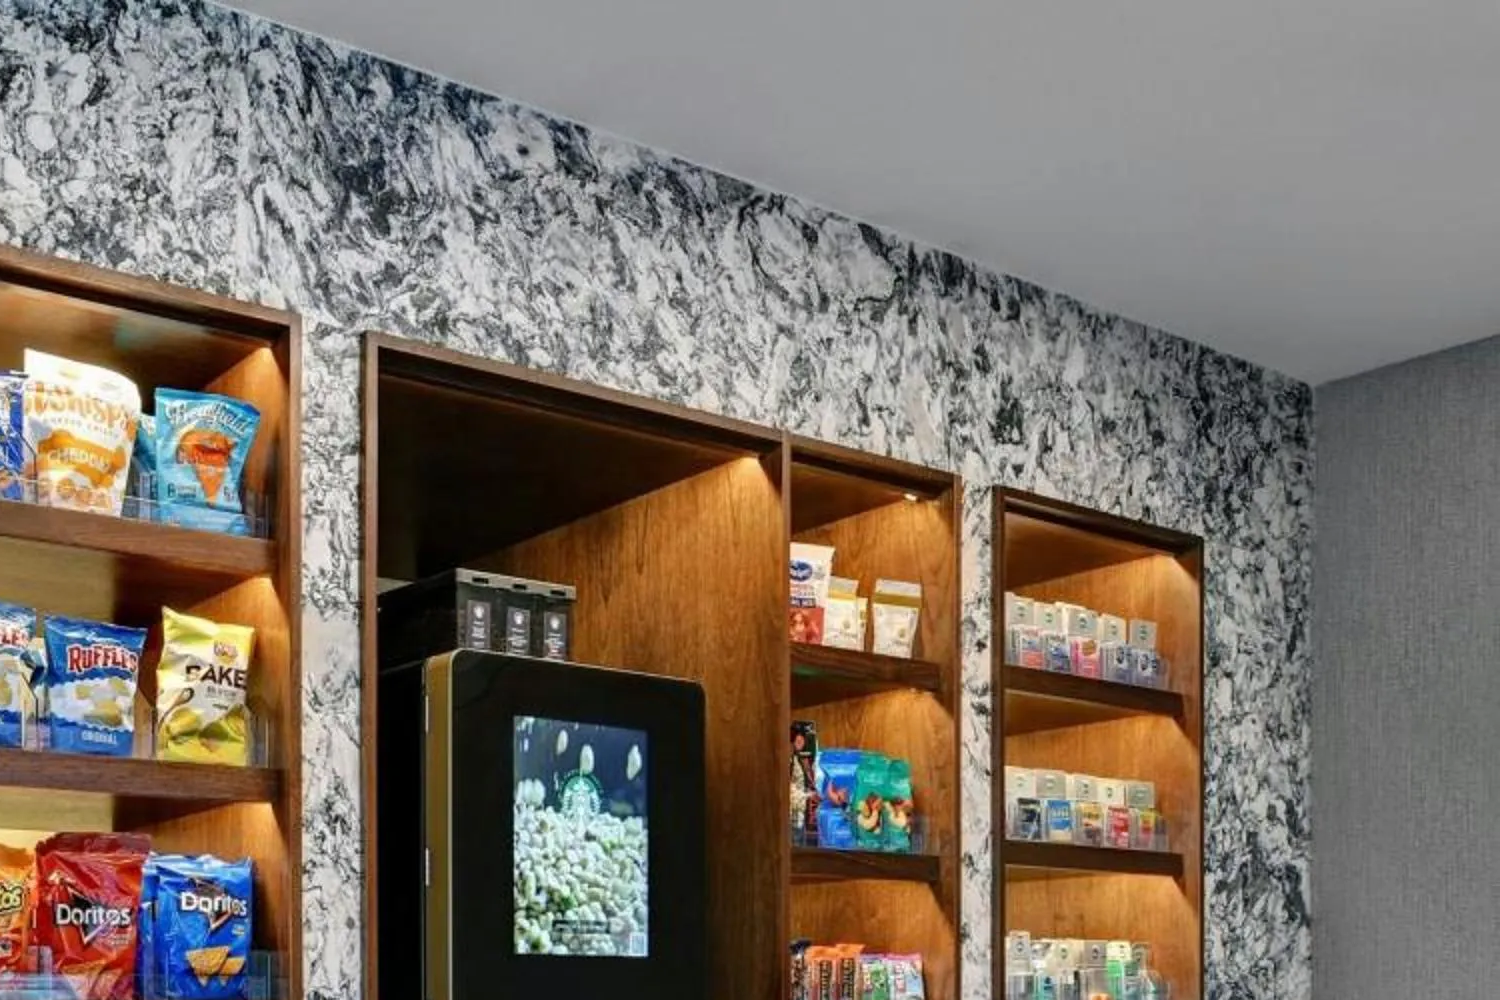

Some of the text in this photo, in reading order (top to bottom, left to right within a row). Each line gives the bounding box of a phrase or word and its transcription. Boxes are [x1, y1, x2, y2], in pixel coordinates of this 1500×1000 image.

[67, 644, 139, 673] RUFFLES
[56, 903, 131, 925] Doritos
[180, 890, 249, 917] Doritos
